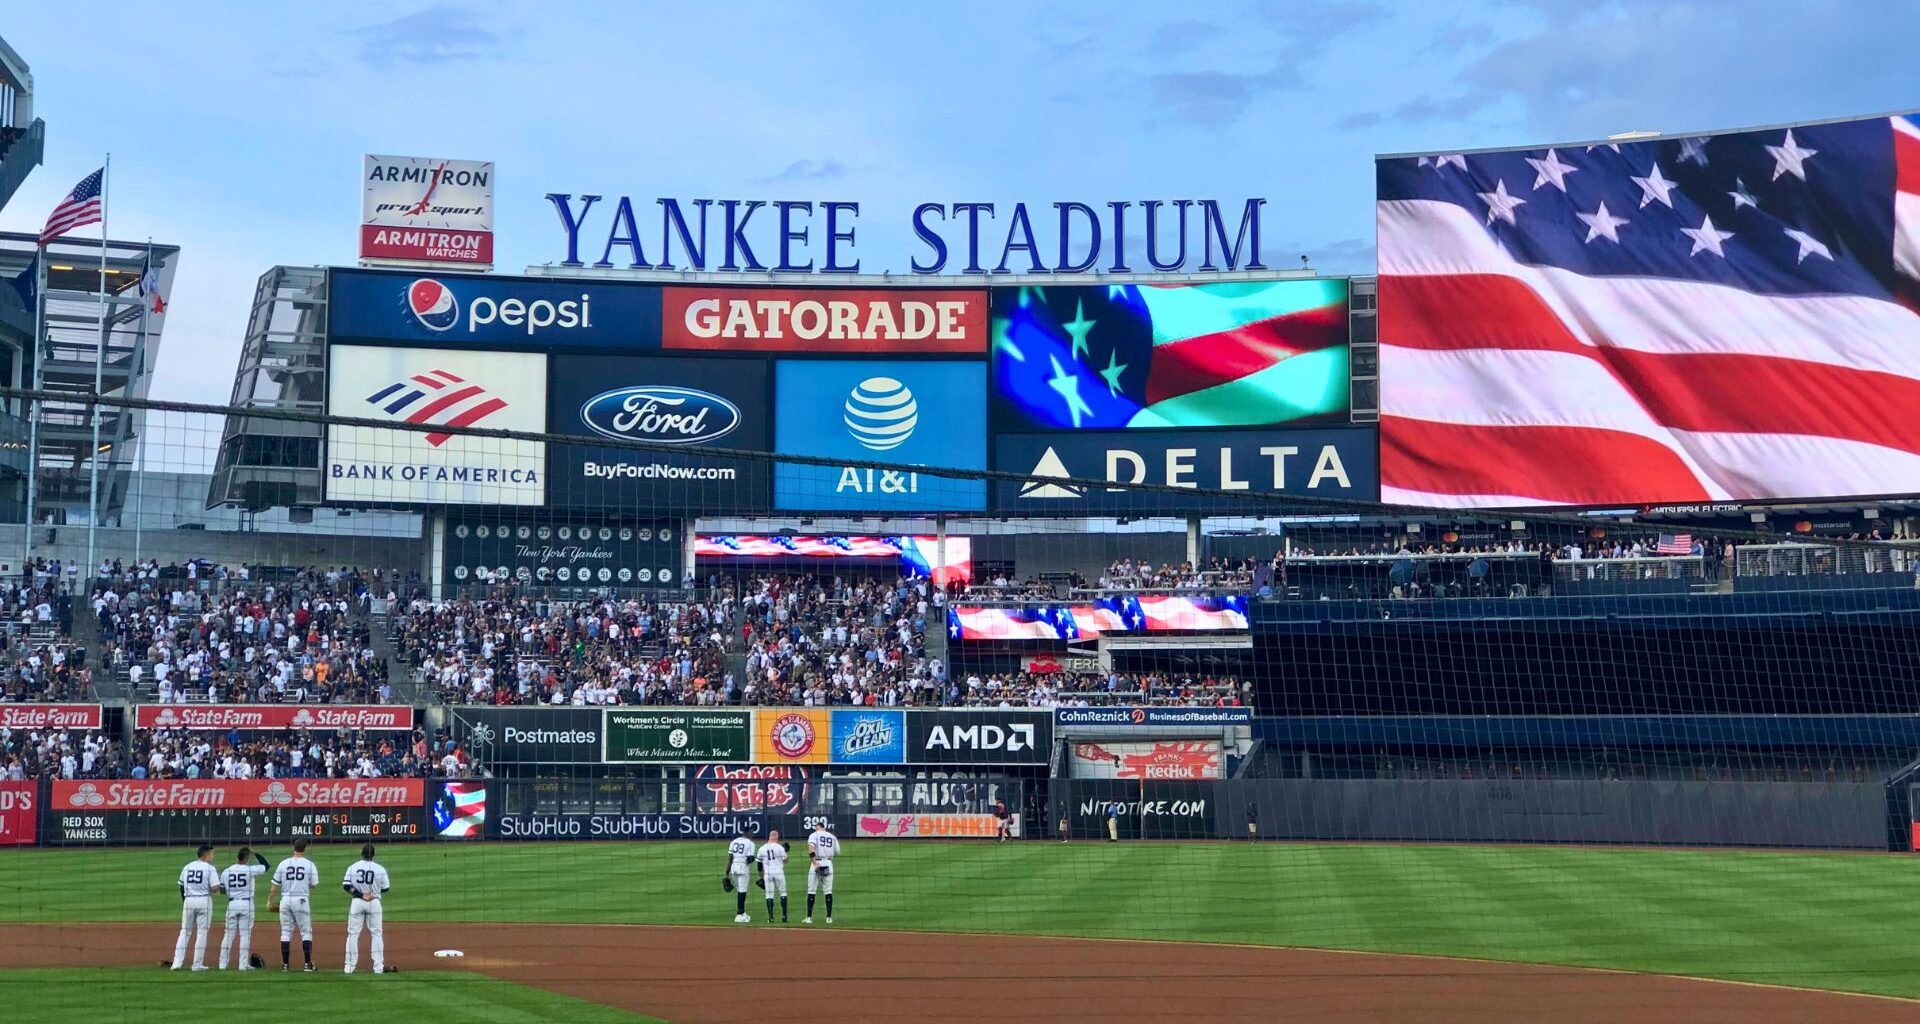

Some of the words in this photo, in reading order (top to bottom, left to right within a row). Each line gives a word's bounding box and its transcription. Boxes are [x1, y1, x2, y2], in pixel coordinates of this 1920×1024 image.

[369, 165, 488, 187] ARMITRON
[430, 206, 484, 216] sport
[373, 230, 480, 250] ARMITRON
[545, 193, 860, 273] YANKEE
[911, 197, 1268, 274] STADIUM
[426, 248, 478, 259] WATCHES
[469, 294, 590, 334] pepsi
[685, 299, 966, 340] GATORADE
[611, 394, 709, 436] Ford
[331, 463, 394, 481] BANK
[400, 464, 431, 482] OF
[435, 465, 538, 484] AMERICA
[583, 461, 736, 480] BuyFordNow.com
[1105, 444, 1352, 492] DELTA
[836, 464, 925, 493] AT&T
[520, 528, 526, 536] 7
[621, 530, 630, 538] 15
[515, 545, 540, 557] New
[541, 545, 566, 563] York
[569, 545, 613, 563] Yankees
[557, 570, 569, 578] 42
[600, 571, 609, 579] 51
[619, 571, 629, 579] 46
[640, 571, 650, 579] 20
[1, 708, 45, 725] State
[48, 708, 88, 725] Farm
[181, 709, 221, 725] State
[223, 709, 262, 725] Farm
[317, 709, 355, 725] State
[357, 709, 395, 725] Farm
[613, 716, 659, 724] Workmen's
[660, 716, 685, 724] Circle
[693, 717, 743, 725] Morningside
[1060, 711, 1129, 722] CohnReznick
[1149, 712, 1248, 723] BusinessOfBaseball.com
[504, 727, 596, 744] Postmates
[856, 721, 882, 737] OXI
[845, 730, 891, 752] CLEAN
[925, 725, 1005, 750] AMD
[627, 748, 648, 757] What
[651, 748, 681, 757] Matters
[107, 783, 166, 806] State
[168, 783, 225, 805] Farm
[295, 782, 351, 804] State
[353, 782, 407, 803] Farm
[913, 772, 1003, 806] ABOE
[63, 817, 82, 827] RED
[84, 817, 104, 827] SOX
[302, 814, 312, 824] AT
[315, 814, 330, 824] BAT
[369, 814, 386, 823] POS
[501, 817, 581, 835] StubHub
[591, 816, 670, 834] StubHub
[680, 815, 760, 833] StubHub
[64, 828, 107, 839] YANKEES
[292, 825, 312, 835] BALL
[314, 825, 322, 835] 0
[342, 825, 370, 834] STRIKE
[372, 824, 379, 834] 0
[391, 824, 408, 834] OUT
[409, 824, 417, 834] 0
[820, 836, 833, 848] 99
[767, 849, 776, 860] 11
[187, 869, 203, 884] 29
[228, 873, 247, 888] 25
[286, 866, 305, 881] 26
[356, 869, 375, 885] 30
